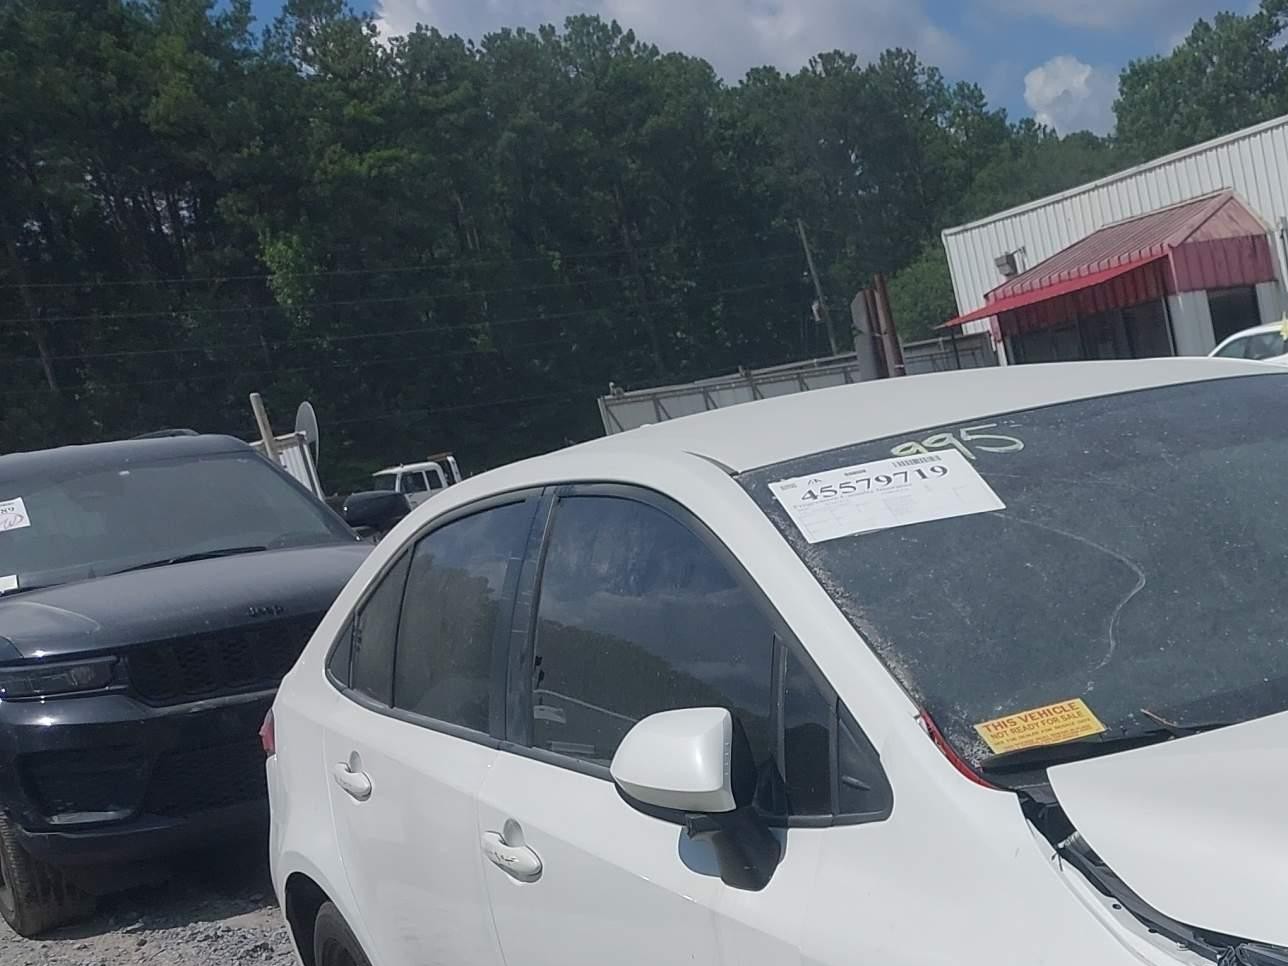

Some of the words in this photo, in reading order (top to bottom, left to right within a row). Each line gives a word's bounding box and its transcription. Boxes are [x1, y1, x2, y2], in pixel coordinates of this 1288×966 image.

[801, 465, 949, 501] 45579719
[983, 717, 1017, 733] THIS
[1018, 701, 1080, 725] VEHICLE
[1011, 722, 1040, 735] READY
[1041, 717, 1061, 727] FOR
[1062, 711, 1083, 722] SALE
